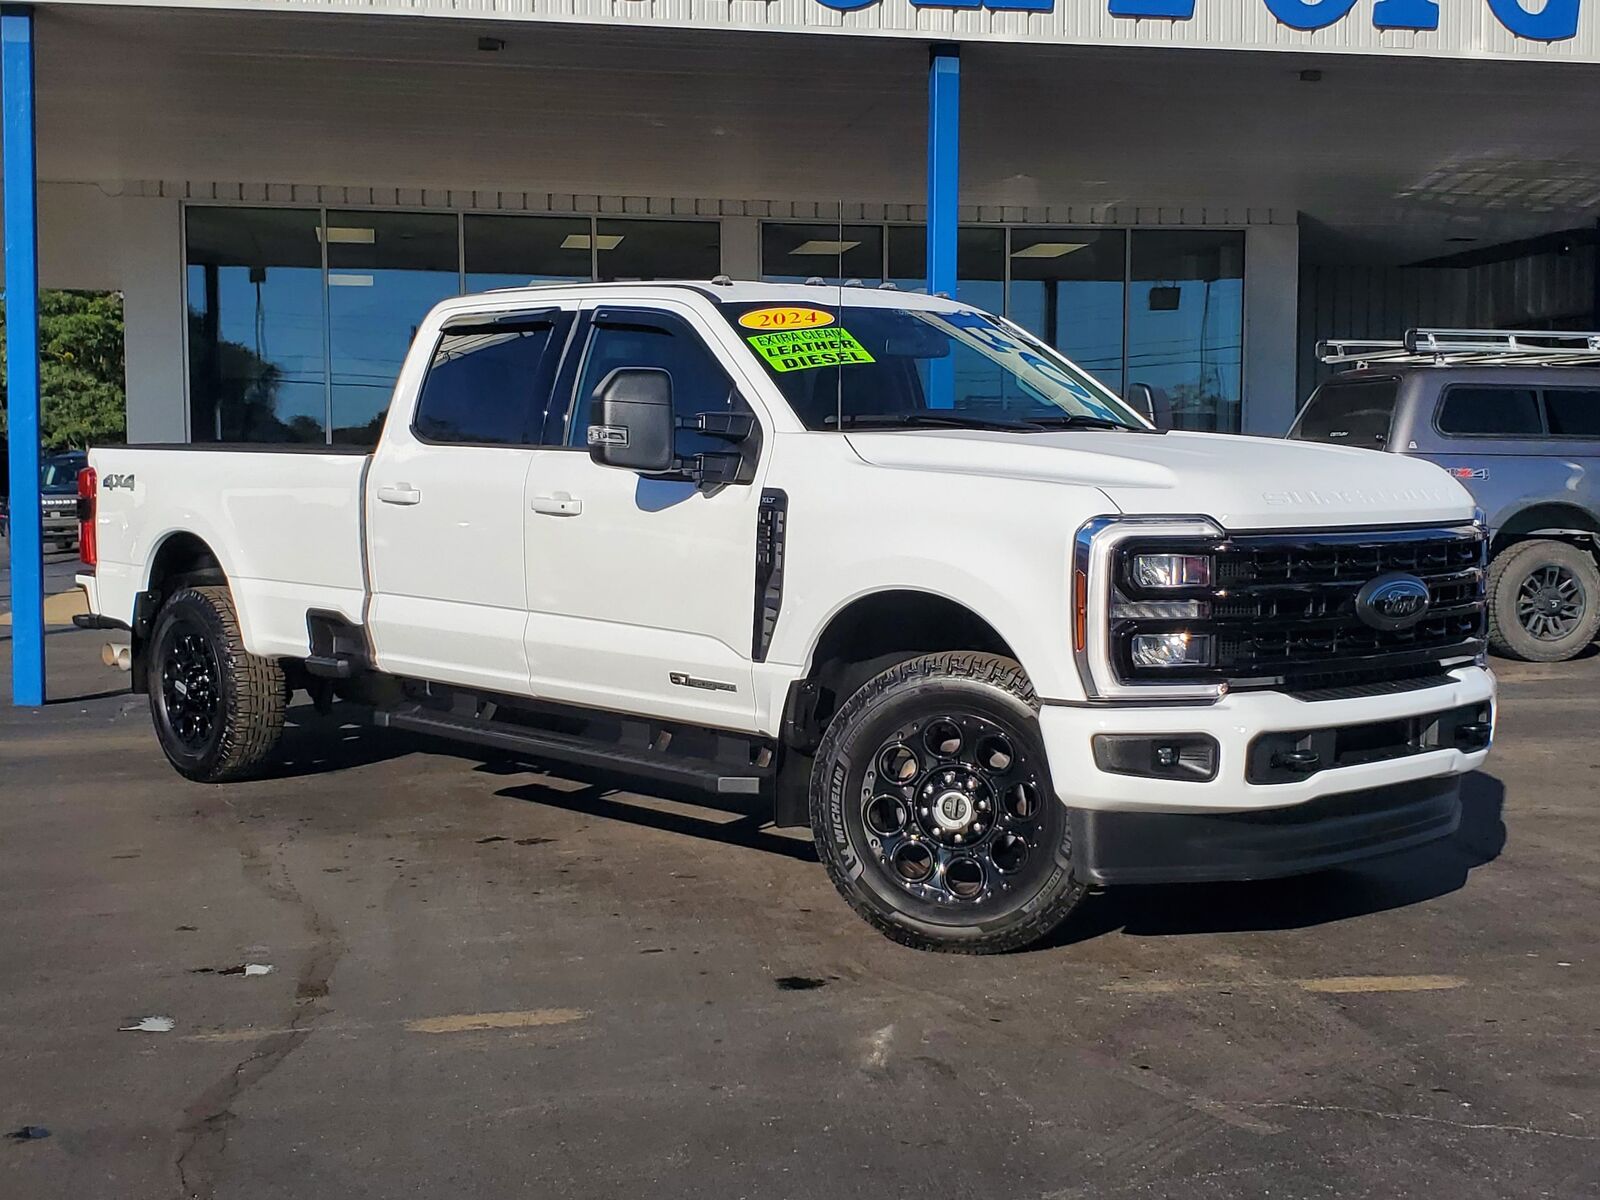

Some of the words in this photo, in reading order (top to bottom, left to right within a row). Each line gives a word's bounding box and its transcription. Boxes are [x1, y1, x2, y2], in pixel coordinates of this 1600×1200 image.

[758, 311, 818, 327] 2024
[757, 331, 801, 346] EXTRA
[801, 329, 843, 340] CLEAN
[766, 340, 855, 358] LEATHER
[781, 352, 865, 369] DIESEL
[761, 496, 776, 504] XLT
[1384, 590, 1418, 614] Ford
[831, 766, 847, 844] MICHELIN
